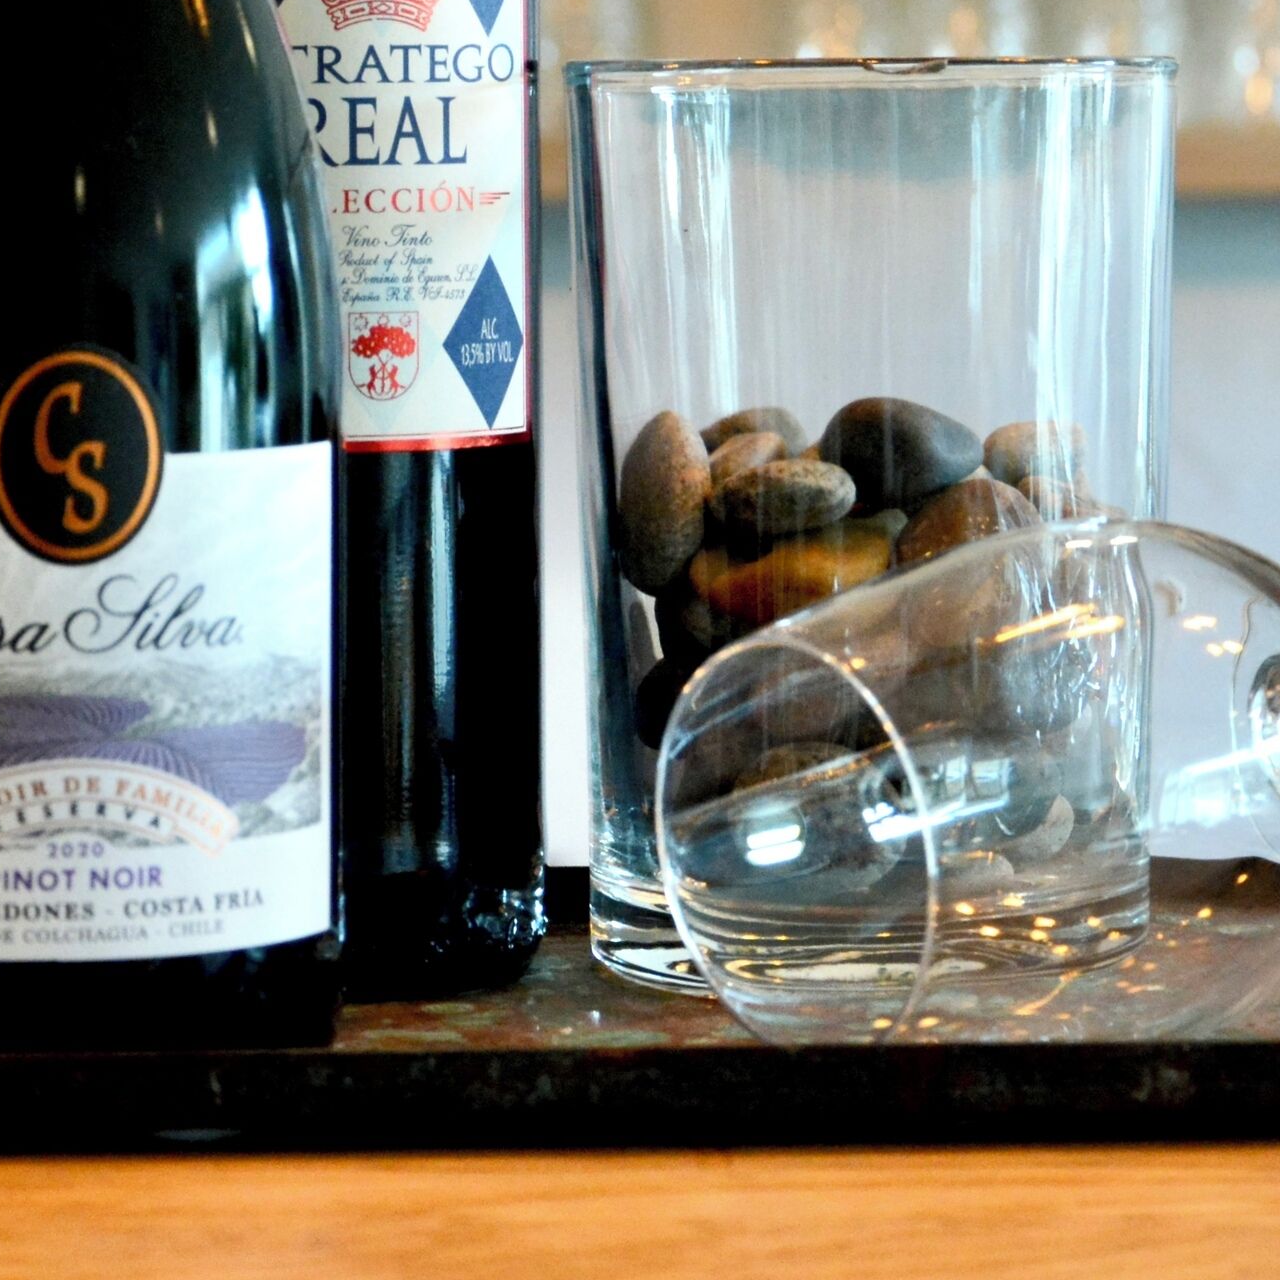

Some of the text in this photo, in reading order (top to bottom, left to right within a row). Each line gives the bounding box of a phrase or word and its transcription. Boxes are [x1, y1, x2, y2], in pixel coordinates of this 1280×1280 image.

[291, 43, 515, 85] RATEGO
[331, 180, 475, 215] ECCIÓN
[342, 223, 434, 248] Vino Tinto
[339, 248, 434, 272] Product of Spain
[402, 269, 415, 284] de
[485, 342, 497, 365] BY
[63, 573, 242, 654] Silva
[64, 777, 100, 794] DE
[46, 841, 105, 859] 2020
[89, 865, 163, 890] NOIR
[123, 895, 204, 919] COSTA
